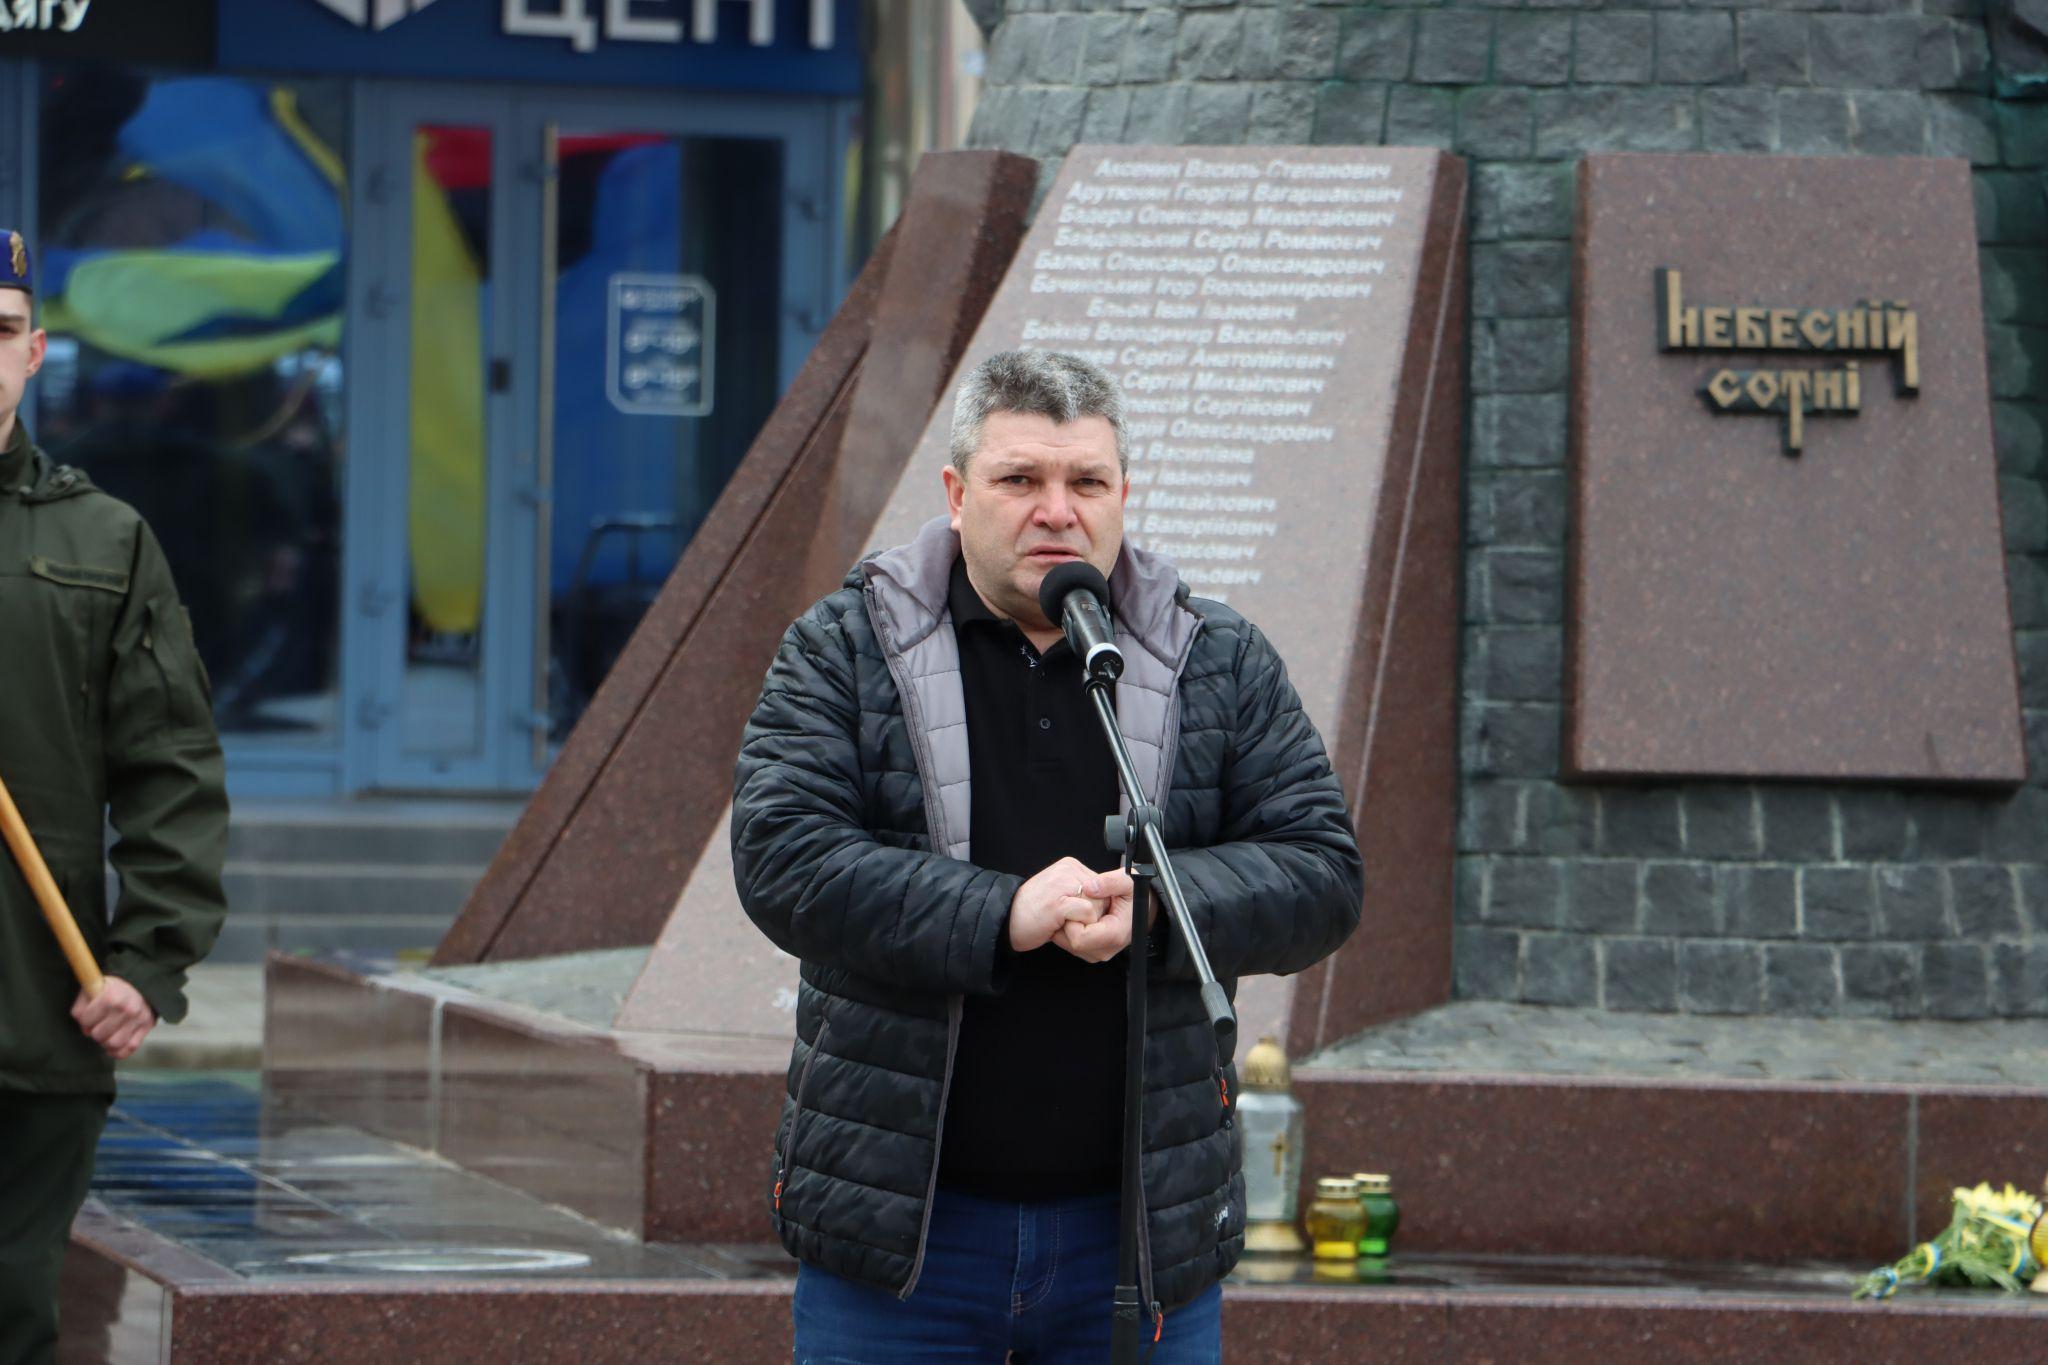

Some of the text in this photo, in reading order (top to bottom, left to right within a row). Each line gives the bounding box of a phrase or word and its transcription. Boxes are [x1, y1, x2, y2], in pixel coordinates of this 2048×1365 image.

[1195, 230, 1261, 251] Сергій
[1121, 348, 1187, 368] Сергій
[1124, 371, 1189, 393] Сергій
[1127, 396, 1312, 417] лексій Сергійович
[1706, 361, 1861, 452] СОТНІ
